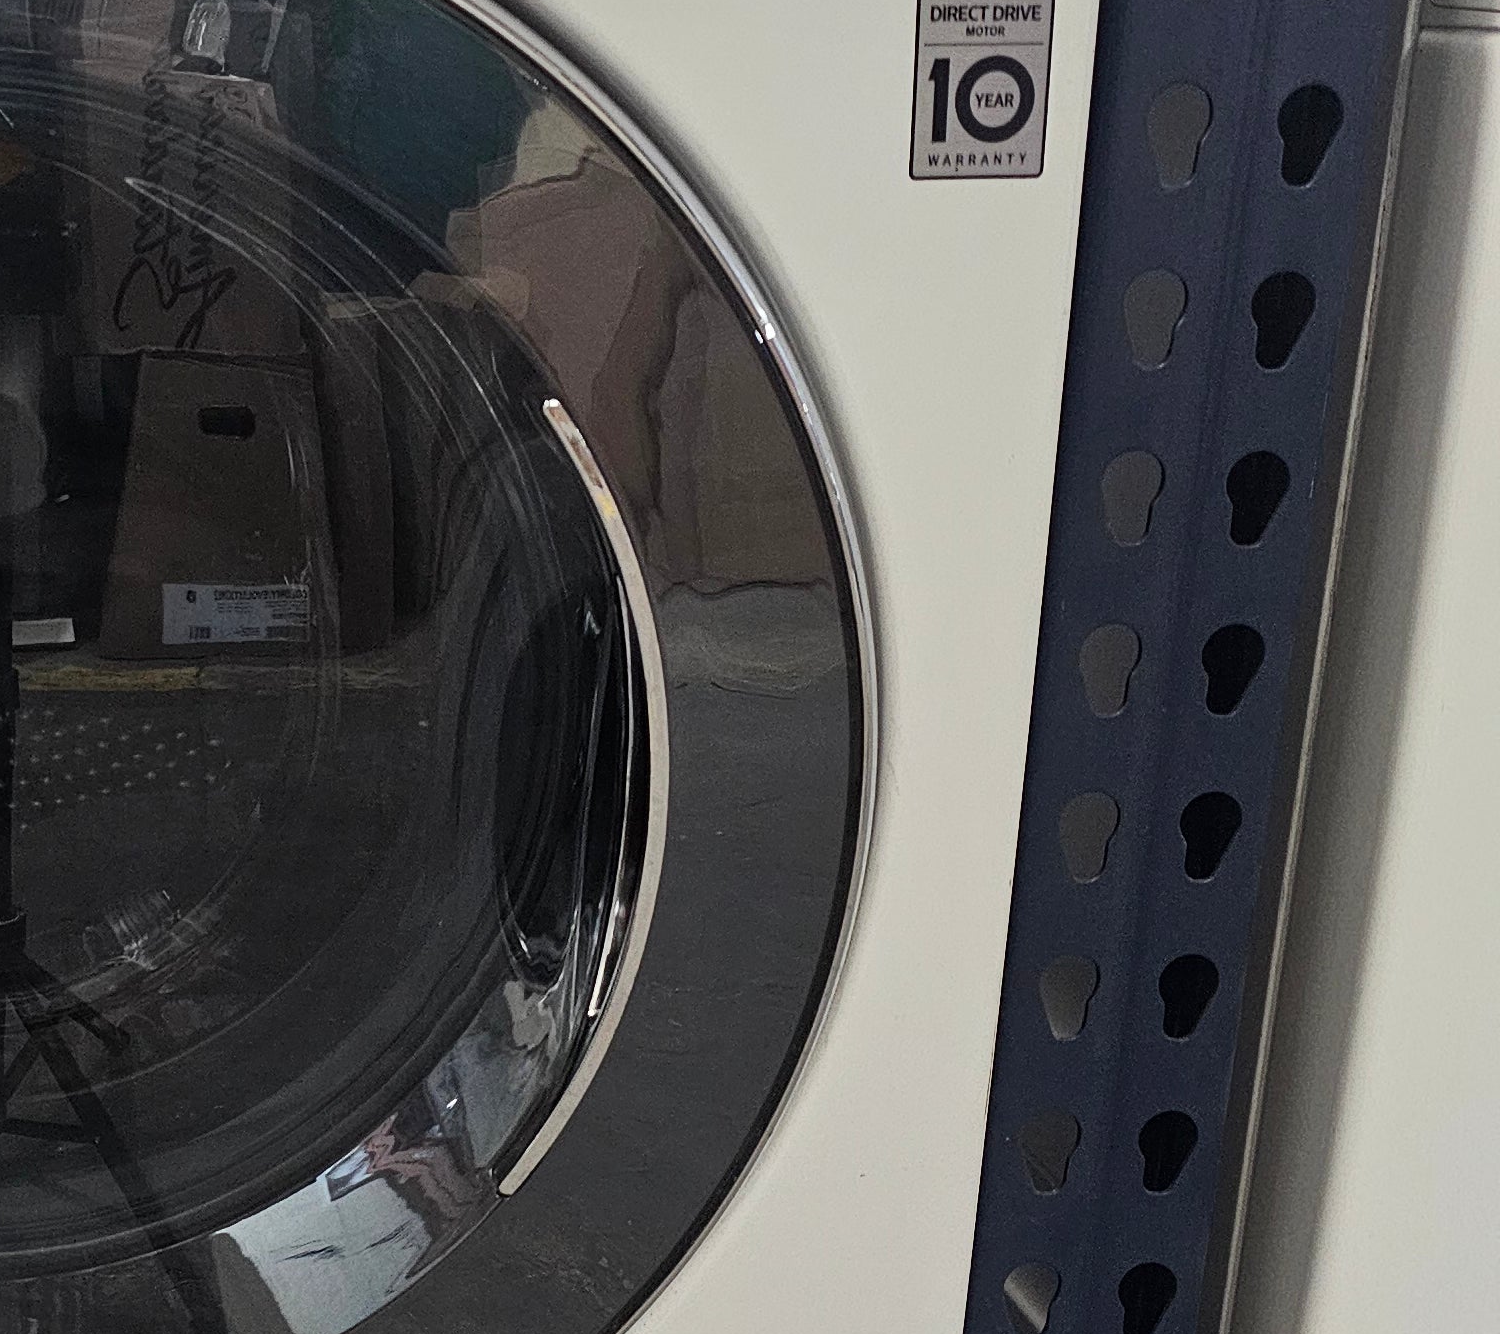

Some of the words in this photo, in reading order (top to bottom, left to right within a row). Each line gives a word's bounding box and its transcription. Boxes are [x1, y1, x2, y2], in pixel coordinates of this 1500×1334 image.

[930, 4, 990, 23] DIRECT
[993, 4, 1042, 22] DRIVE
[966, 25, 1005, 37] MOTOR
[974, 93, 1015, 108] YEAR
[928, 152, 1027, 167] WARRANTY
